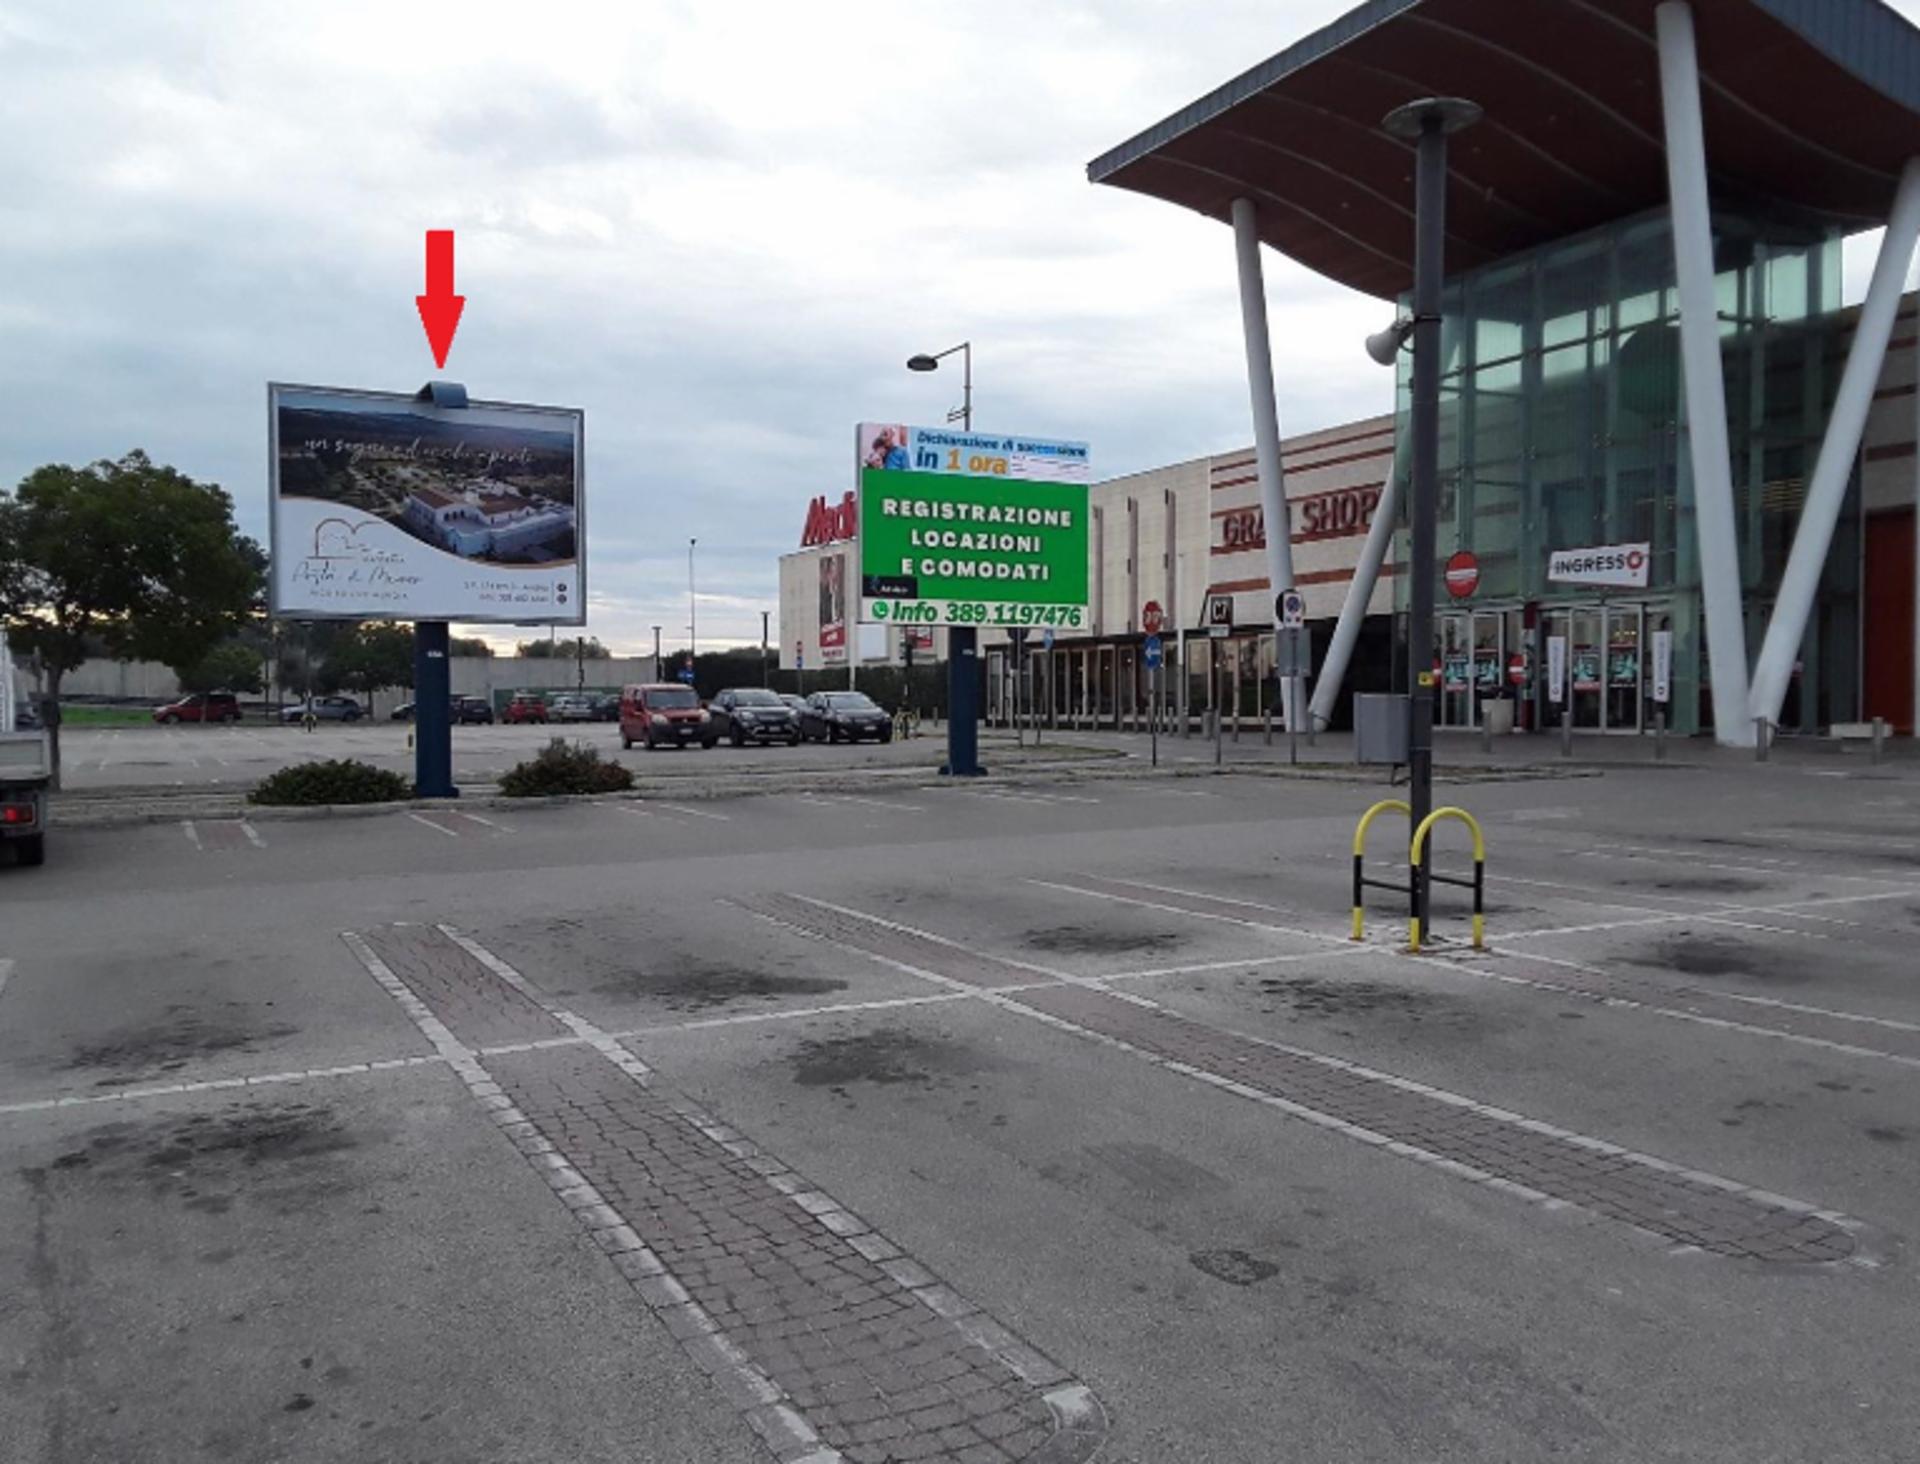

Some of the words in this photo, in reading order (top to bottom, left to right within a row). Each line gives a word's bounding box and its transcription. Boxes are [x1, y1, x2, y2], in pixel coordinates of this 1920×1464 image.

[917, 431, 999, 450] Dichiarazione
[1002, 438, 1013, 450] di
[917, 446, 938, 469] in
[947, 450, 961, 471] 1
[968, 454, 1009, 475] ora
[882, 498, 1072, 527] REGISTRAZIONE
[1223, 508, 1291, 546] GRA
[1300, 489, 1384, 535] SHOP
[911, 528, 1041, 552] LOCAZIONI
[901, 558, 913, 576] E
[920, 558, 1049, 581] COMODATI
[1554, 551, 1644, 574] INGRESSO
[892, 600, 938, 622] Info
[944, 602, 1082, 627] 389.1197476
